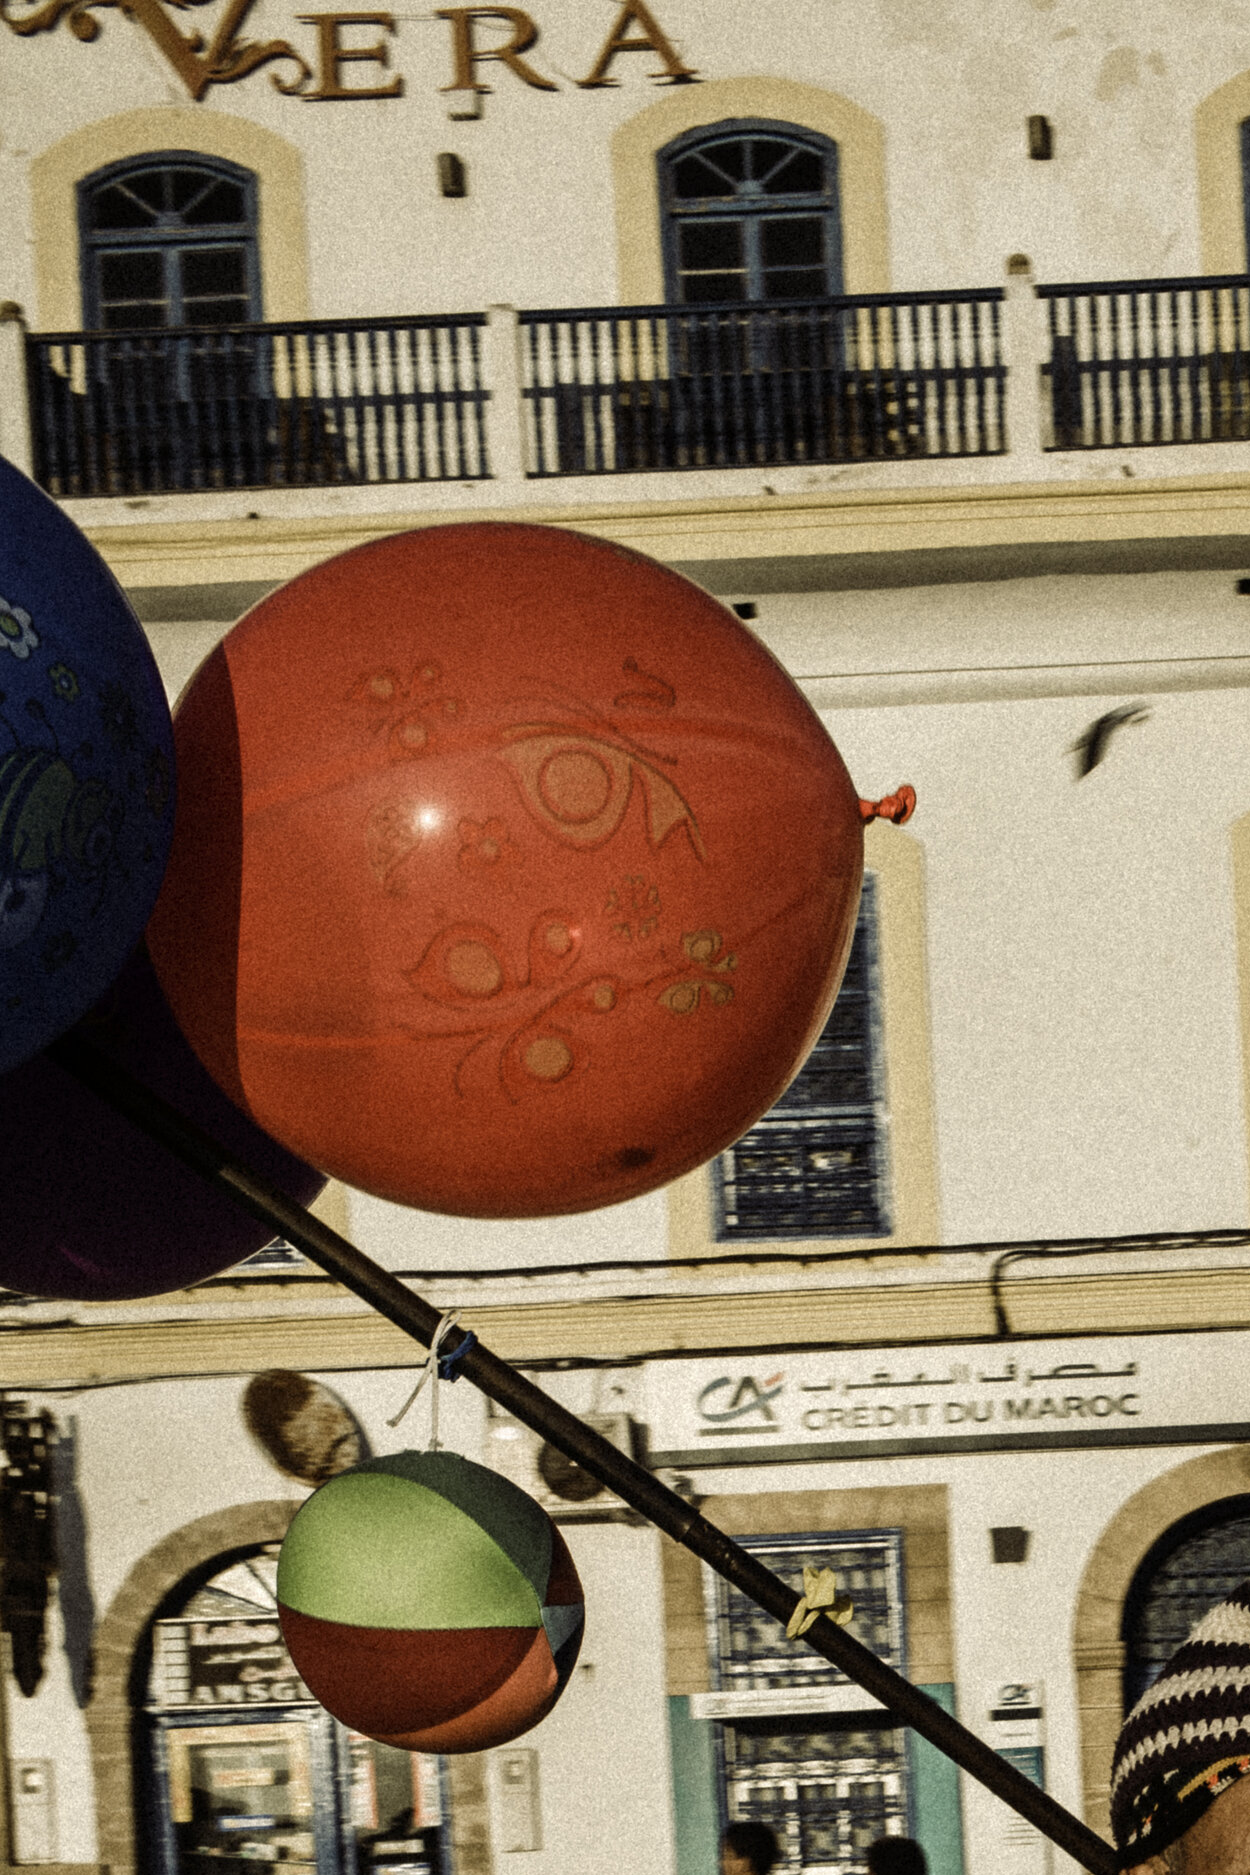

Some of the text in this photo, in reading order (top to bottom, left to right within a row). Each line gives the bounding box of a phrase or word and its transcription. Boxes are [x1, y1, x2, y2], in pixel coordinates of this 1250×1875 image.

[2, 0, 704, 101] VERA
[946, 1399, 994, 1424] DU
[1004, 1393, 1140, 1422] MAROC
